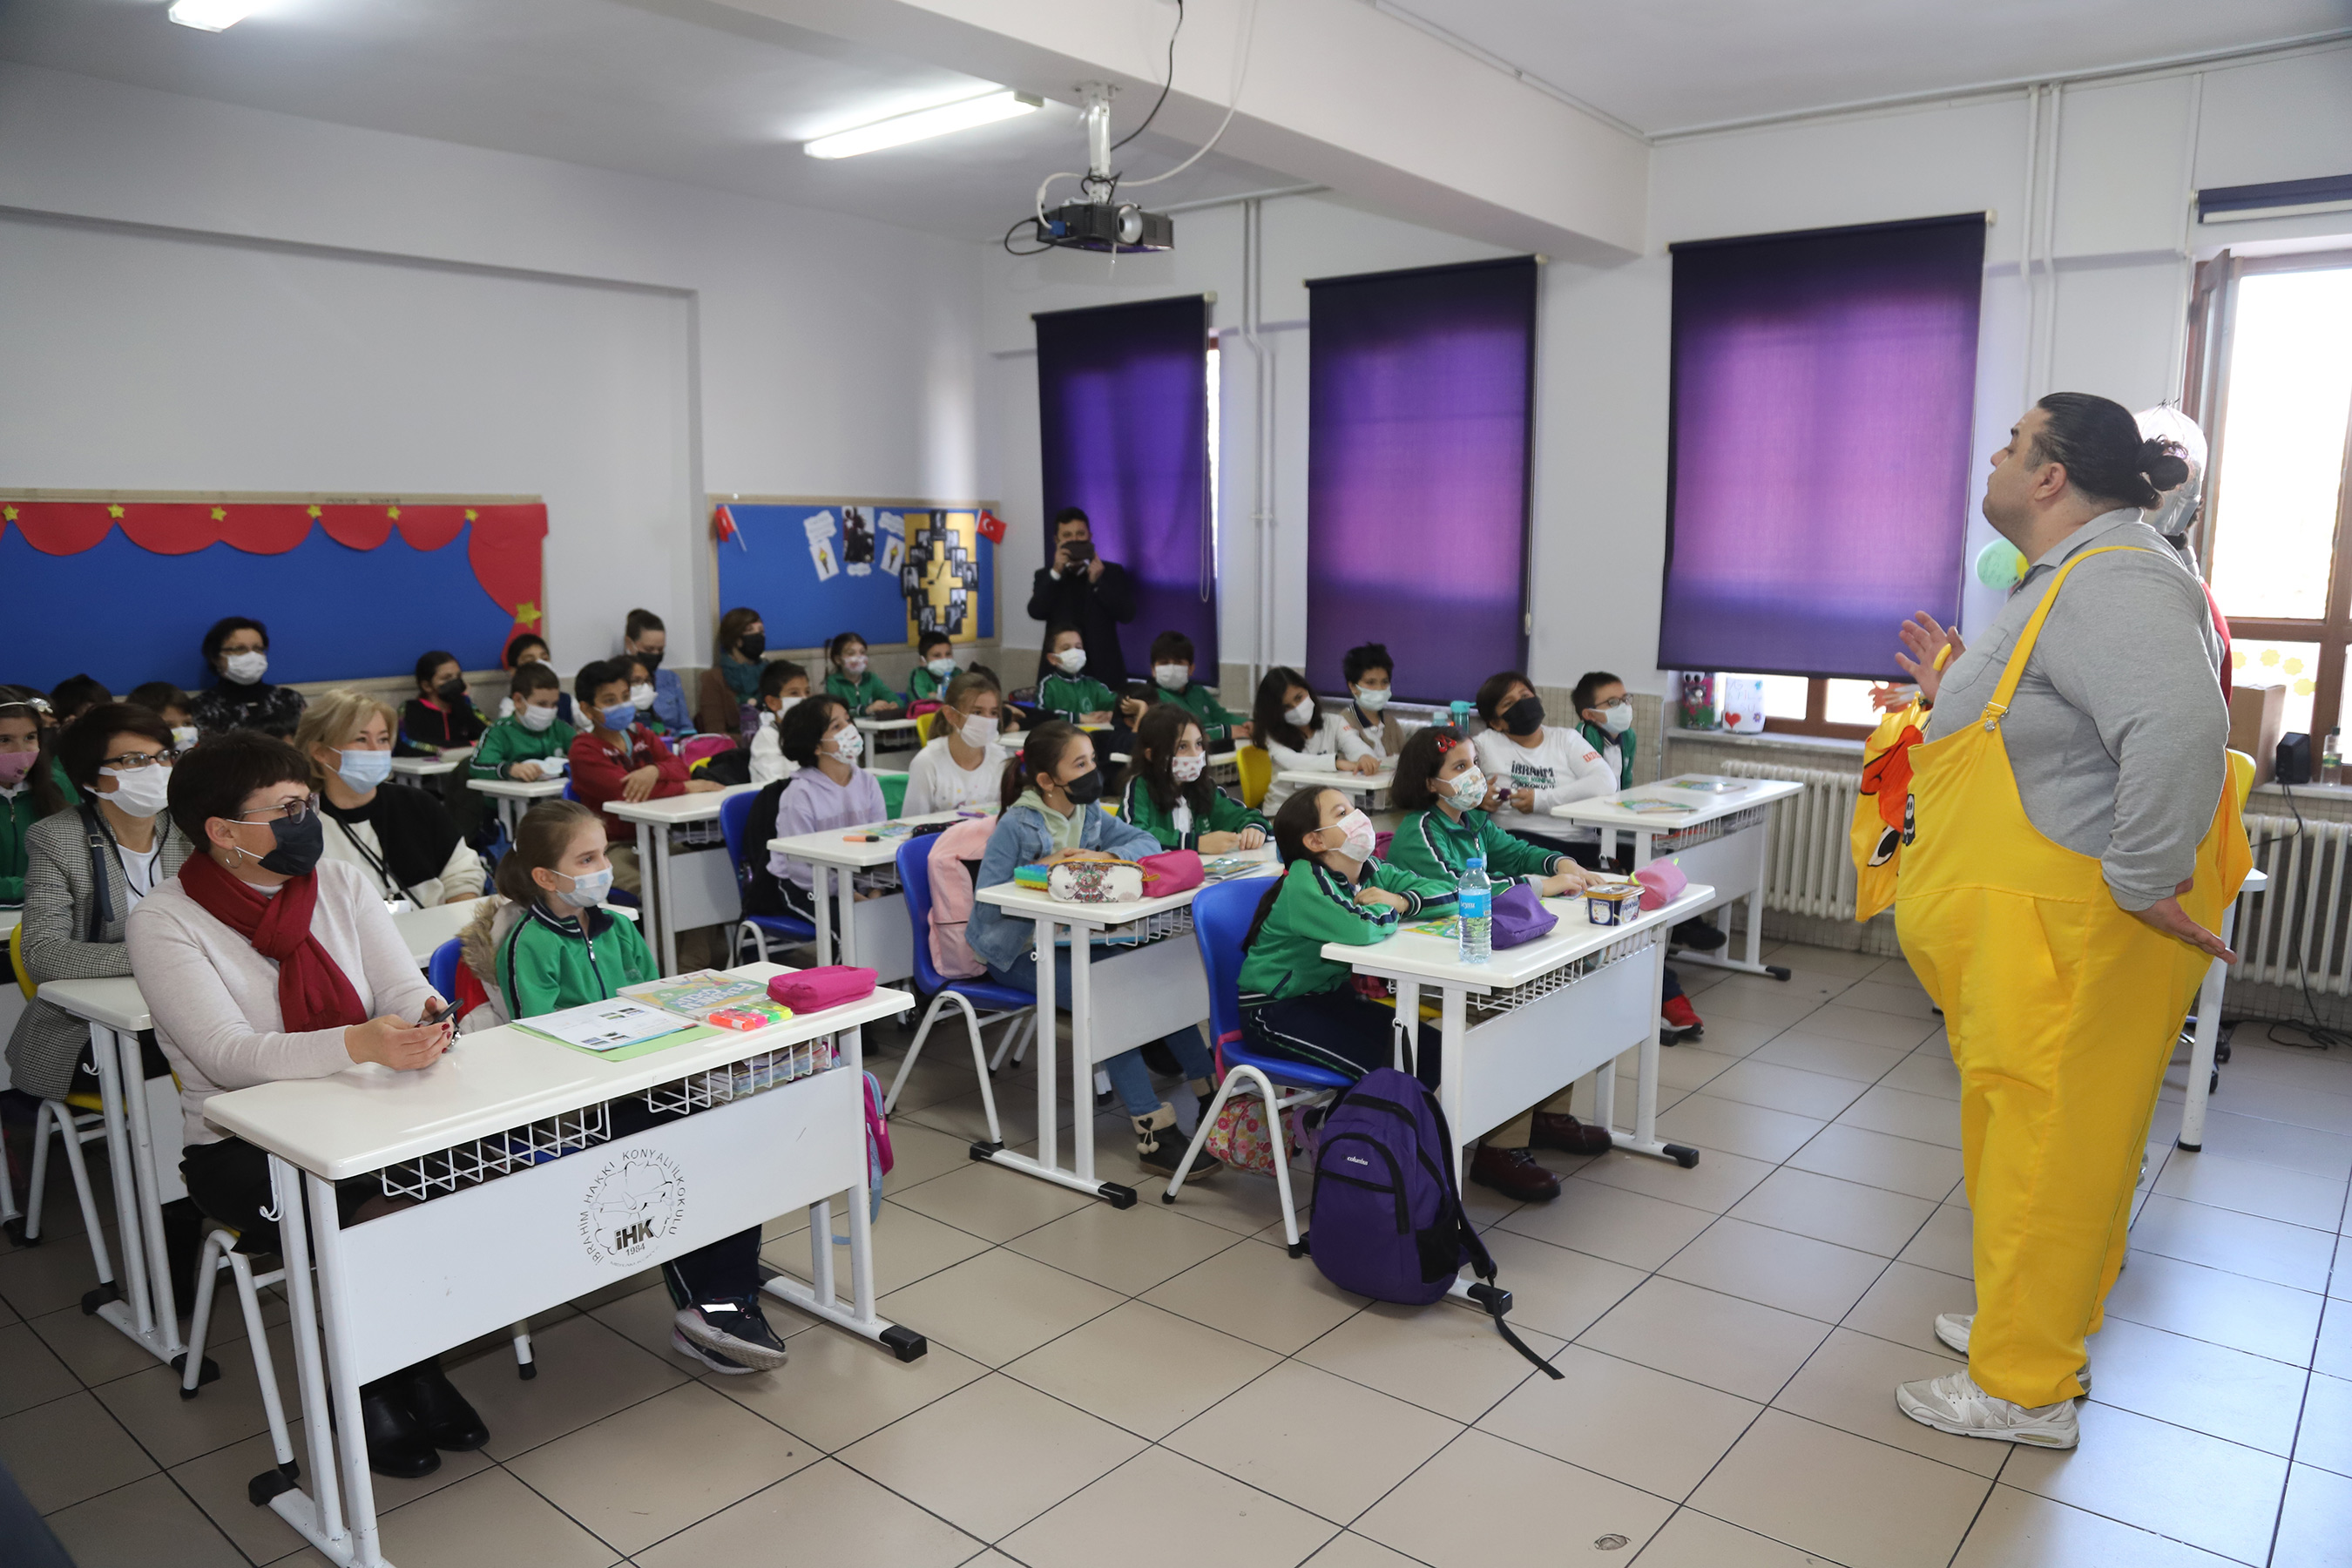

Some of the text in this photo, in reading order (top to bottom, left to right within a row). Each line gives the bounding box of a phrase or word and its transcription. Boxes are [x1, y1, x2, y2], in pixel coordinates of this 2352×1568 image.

[584, 1161, 616, 1204] HAKKI
[577, 1211, 605, 1266] İBRAHİM
[625, 1243, 645, 1256] 1984
